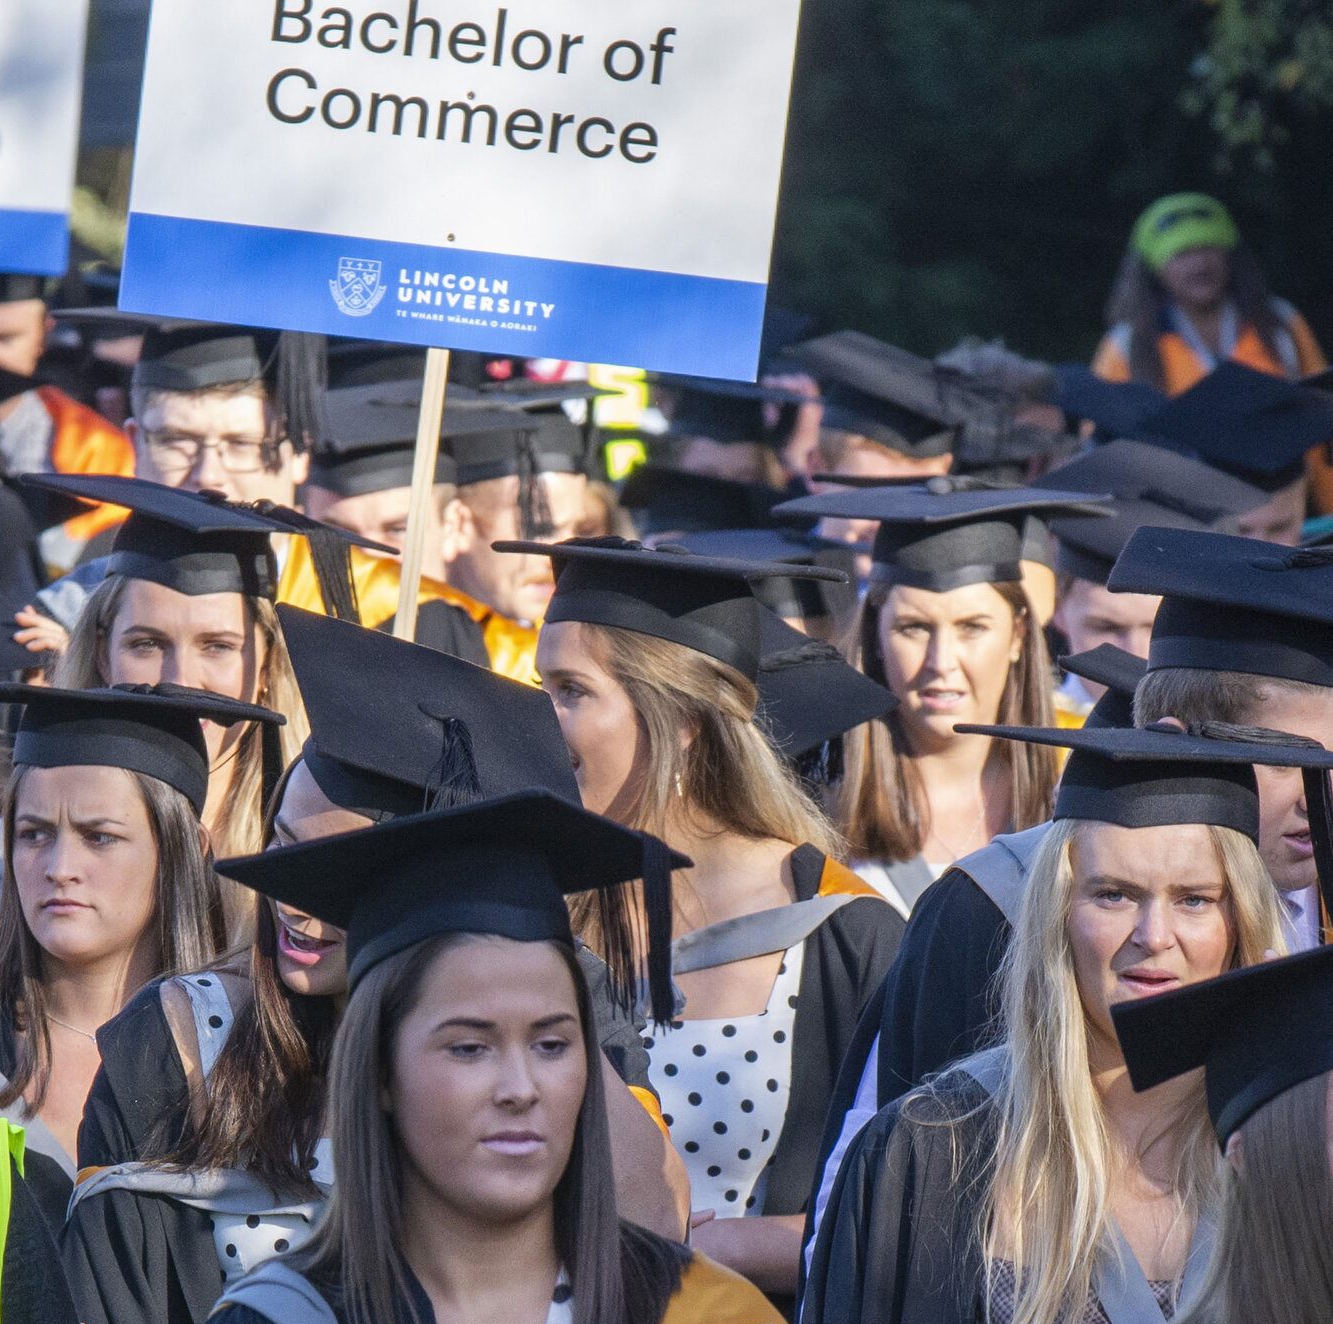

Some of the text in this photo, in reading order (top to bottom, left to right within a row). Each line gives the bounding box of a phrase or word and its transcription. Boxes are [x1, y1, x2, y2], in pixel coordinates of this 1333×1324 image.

[271, 0, 678, 86] Bachelor of
[266, 67, 660, 164] Commerce
[398, 268, 509, 295] LINCOLN
[397, 286, 556, 319] UNIVERSITY
[411, 312, 444, 321] WHARE
